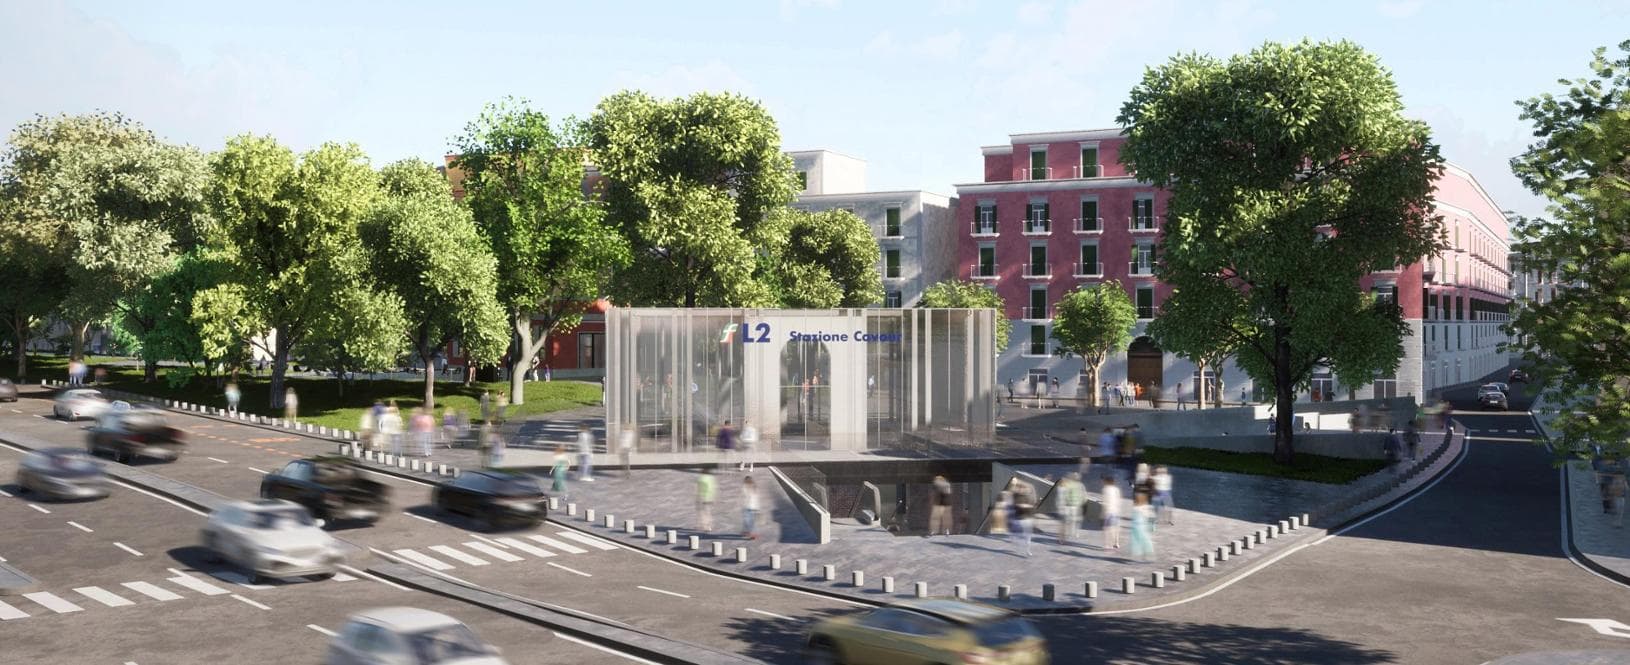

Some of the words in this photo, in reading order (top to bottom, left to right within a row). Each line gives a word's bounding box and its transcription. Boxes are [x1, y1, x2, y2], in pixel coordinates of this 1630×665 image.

[742, 323, 771, 342] L2
[789, 330, 848, 342] Stazione
[853, 330, 902, 342] Cavour
